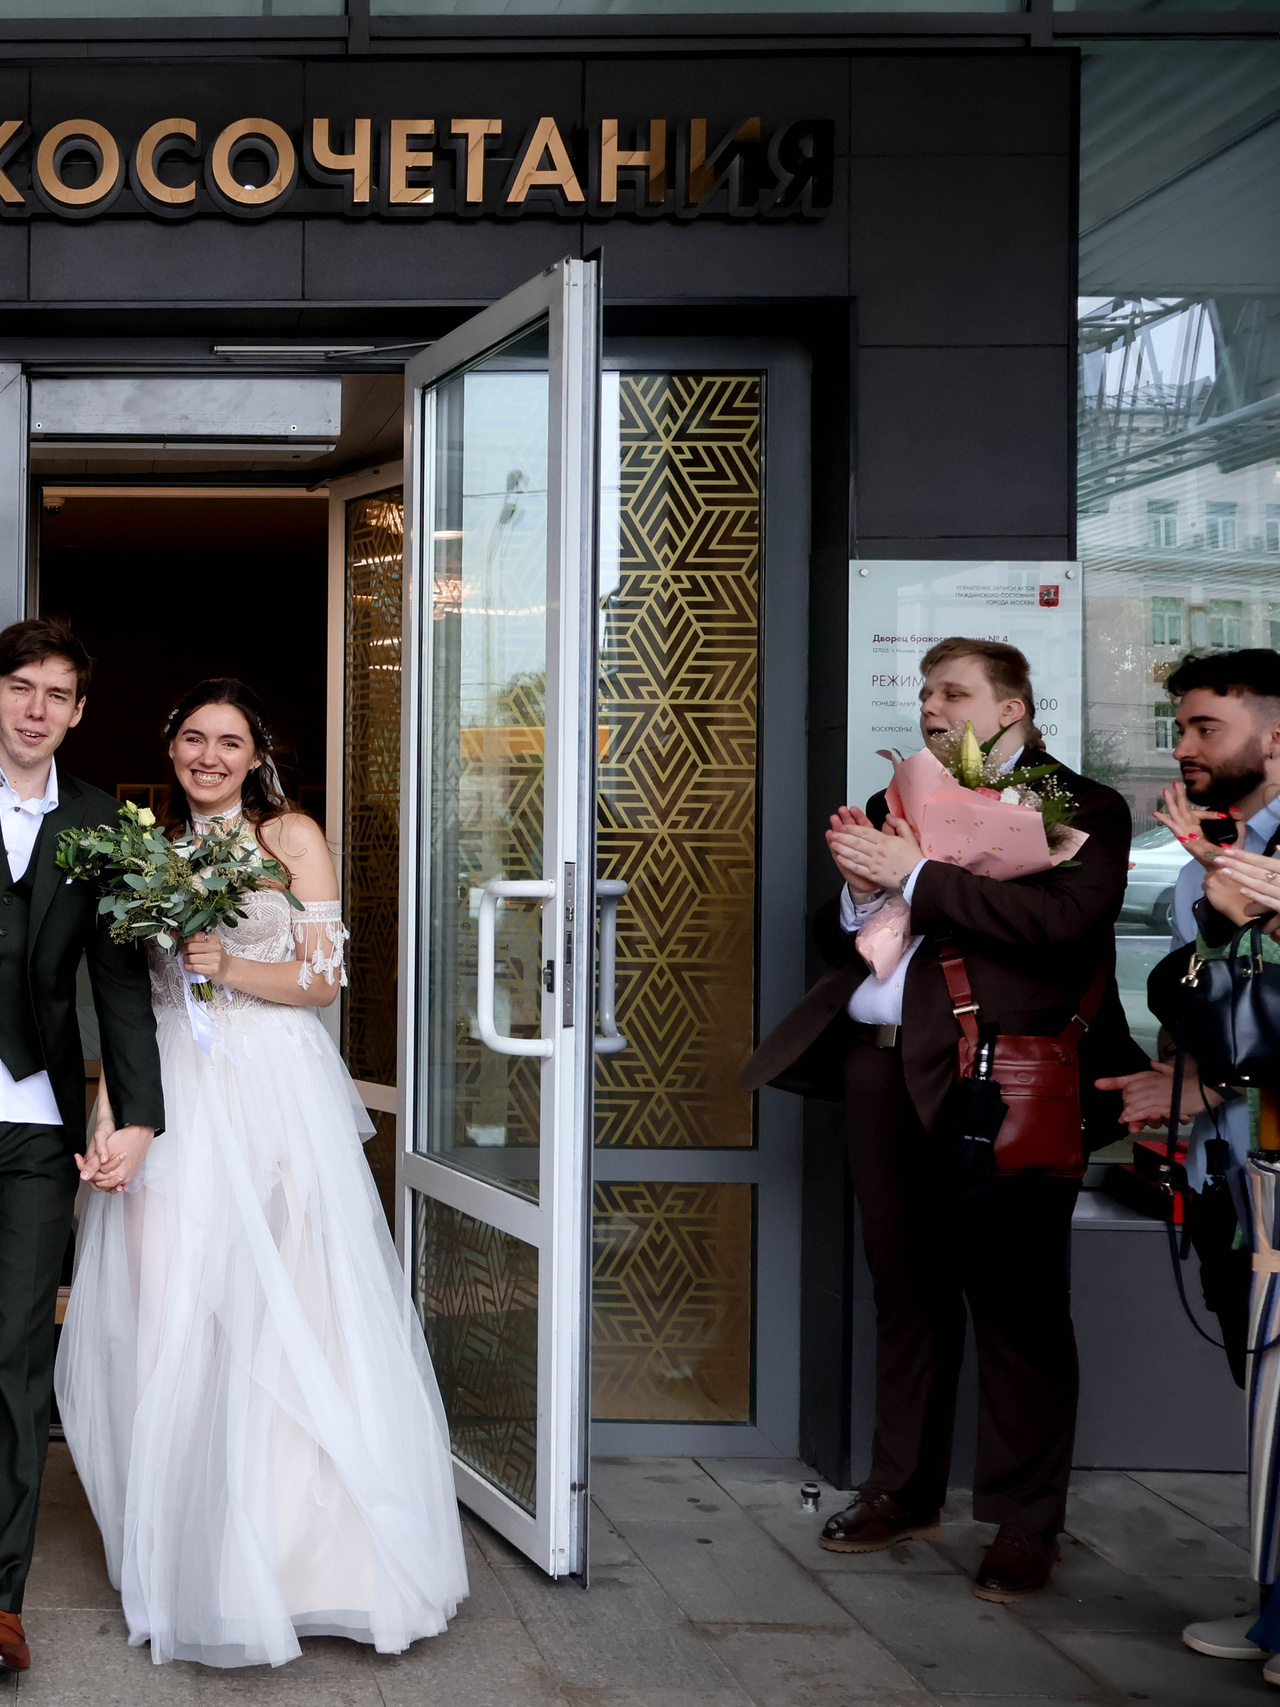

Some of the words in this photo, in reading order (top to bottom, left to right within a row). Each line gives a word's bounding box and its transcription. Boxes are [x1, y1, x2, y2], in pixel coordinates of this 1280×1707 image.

[872, 634, 908, 644] Дворец
[1002, 635, 1009, 643] 4
[871, 674, 925, 687] РЕЖИМ
